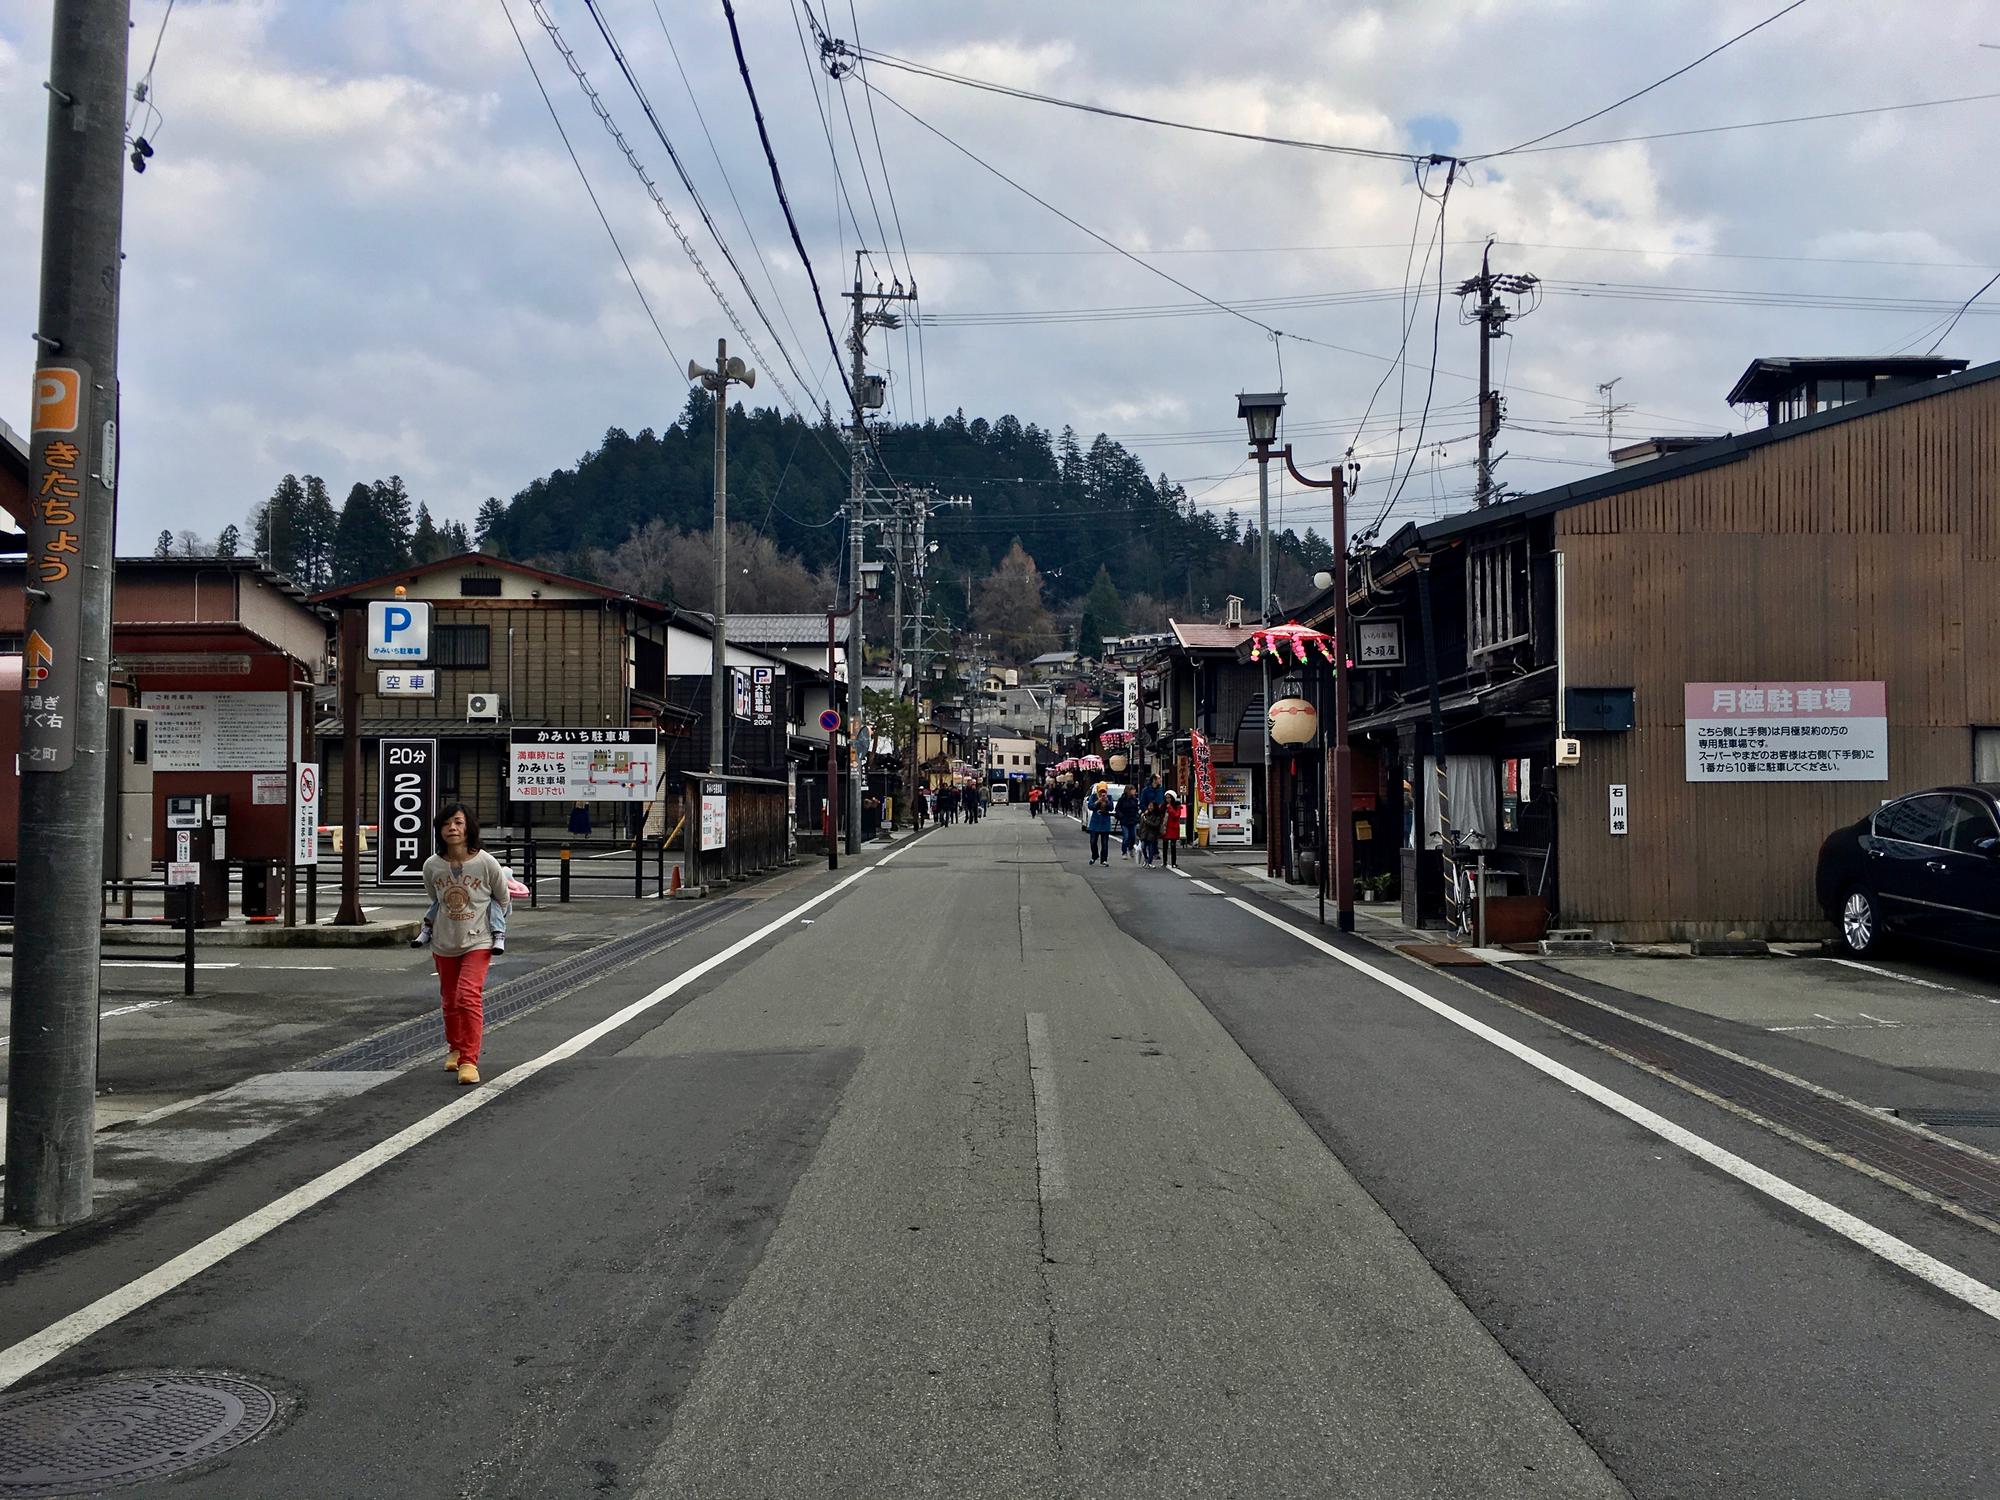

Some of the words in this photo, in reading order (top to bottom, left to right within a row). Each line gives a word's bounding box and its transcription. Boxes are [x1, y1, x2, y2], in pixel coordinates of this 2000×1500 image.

[39, 441, 80, 583] きたちょう
[384, 607, 412, 643] P
[756, 670, 767, 682] P
[386, 675, 425, 690] 空車
[1711, 688, 1851, 713] 月極駐車場
[537, 731, 630, 742] かみいち駐車場
[1697, 726, 1848, 737] こちら側(上手側)は月極契約の方の
[1698, 739, 1769, 749] 専用駐車場です。
[389, 748, 427, 765] 20分
[517, 751, 565, 760] 満車時には
[1698, 750, 1875, 761] スーパーやまだのお客様は右側(下手側)に
[517, 763, 566, 773] かみいち
[1701, 762, 1840, 773] 1番から10番に駐車してください。
[517, 776, 566, 785] 第2駐車場
[517, 787, 565, 796] へお回り下さい
[1612, 788, 1624, 830] 石川様
[393, 773, 422, 860] 200円
